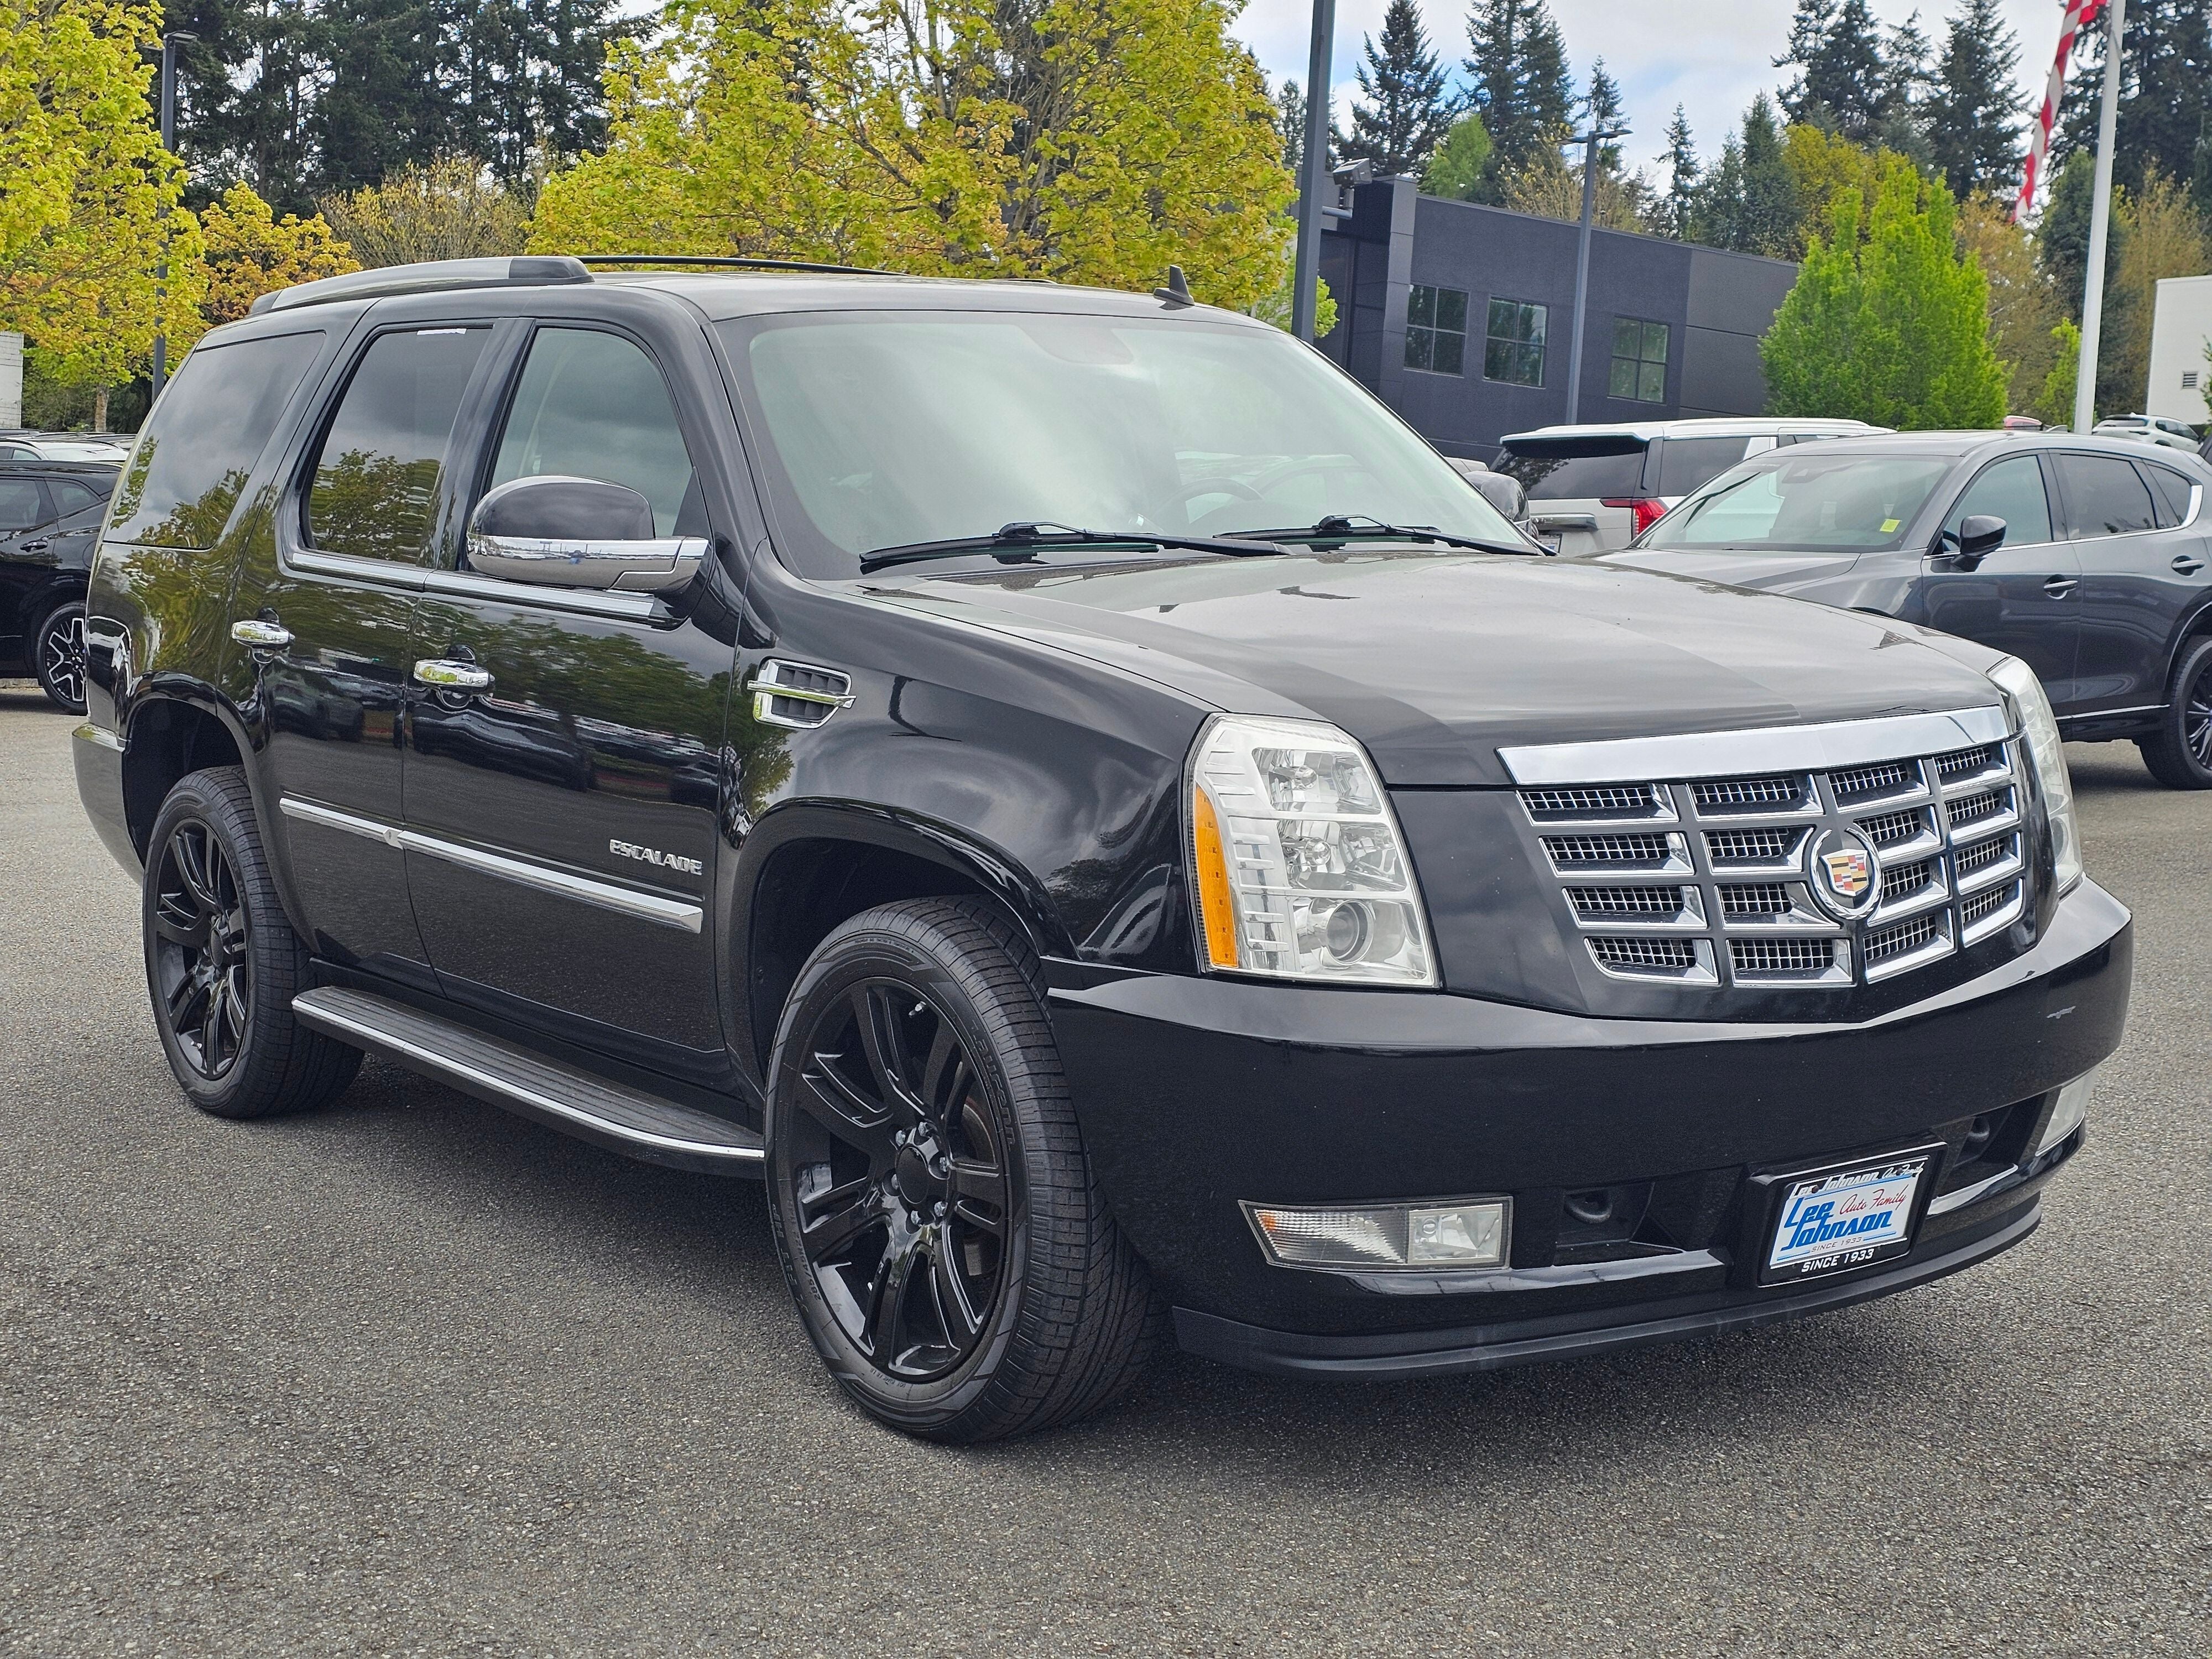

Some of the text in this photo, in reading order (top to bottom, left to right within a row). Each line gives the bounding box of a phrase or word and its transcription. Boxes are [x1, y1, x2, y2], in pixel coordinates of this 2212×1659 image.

[609, 839, 703, 875] ESCALADE
[1784, 1197, 1835, 1228] Lee
[1840, 1184, 1906, 1214] Auto Family
[1781, 1211, 1892, 1251] Johnson
[1811, 1237, 1862, 1252] SINCE 1933
[1801, 1248, 1875, 1272] SINCE 1933
